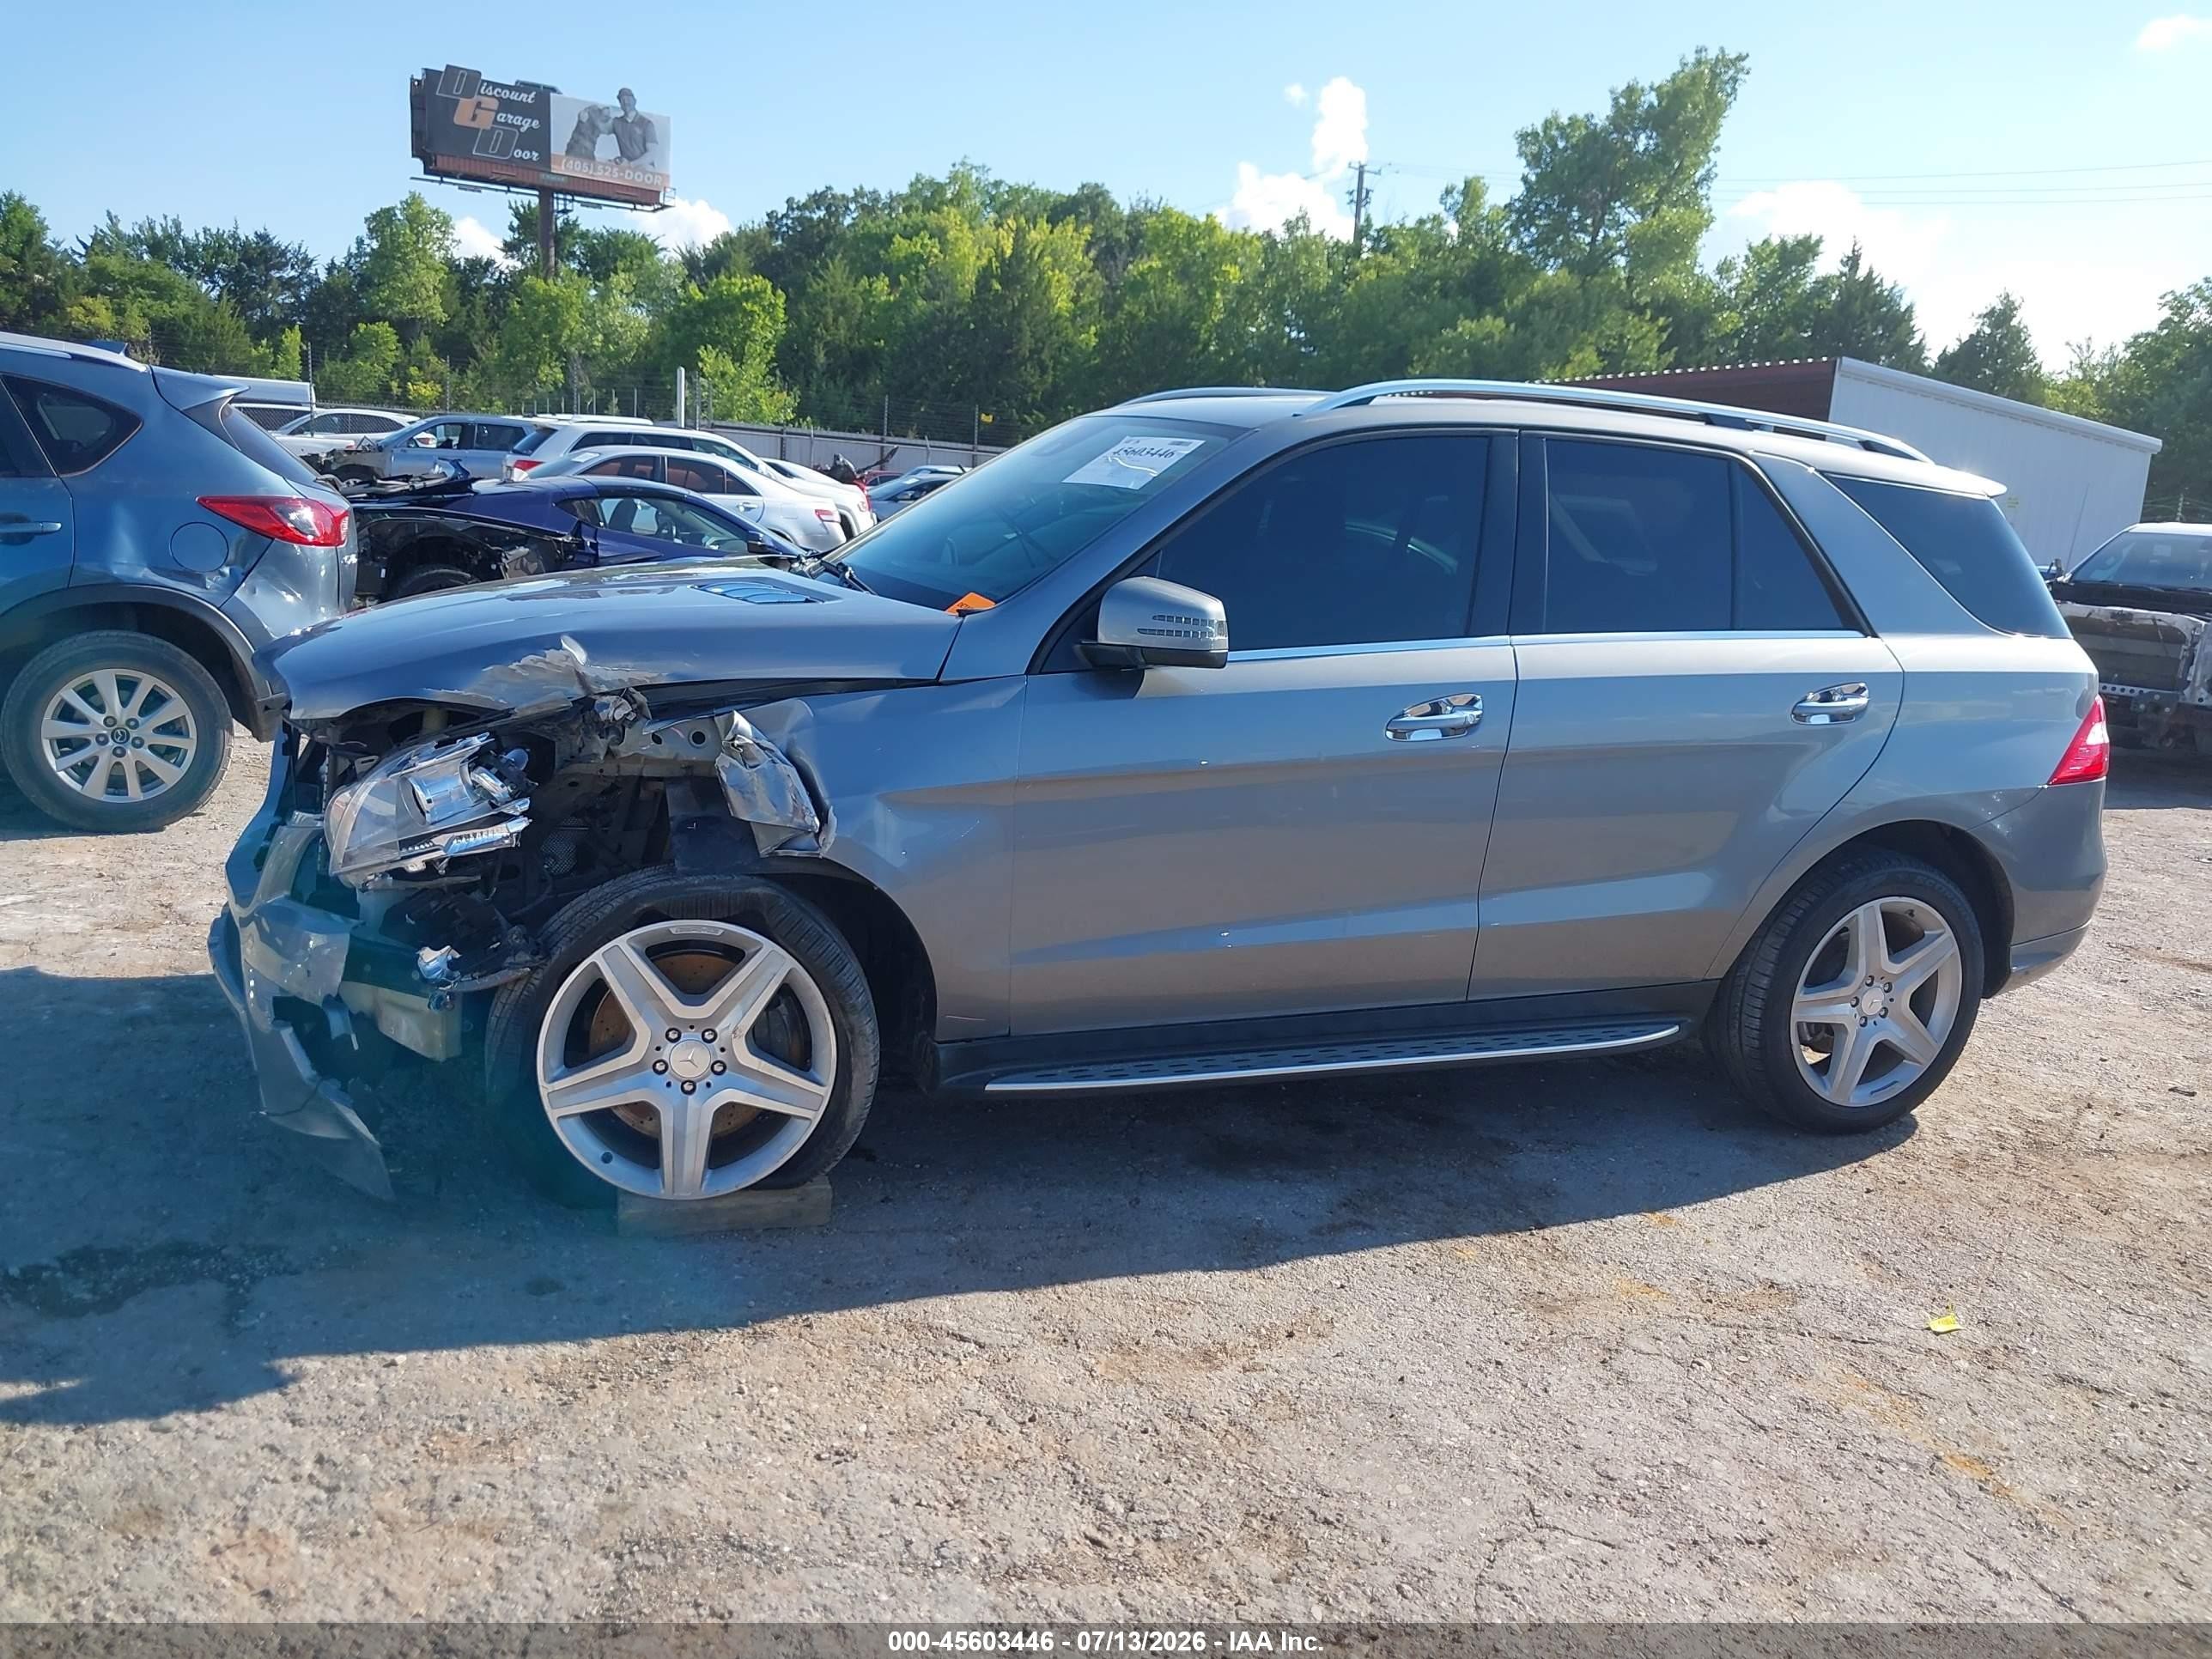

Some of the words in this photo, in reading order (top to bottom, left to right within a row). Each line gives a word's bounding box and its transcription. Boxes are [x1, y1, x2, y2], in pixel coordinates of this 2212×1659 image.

[435, 64, 537, 104] Discount
[453, 95, 541, 133] Garage
[472, 125, 541, 161] Door
[561, 158, 593, 175] (405)
[596, 165, 663, 186] 525-DOOR
